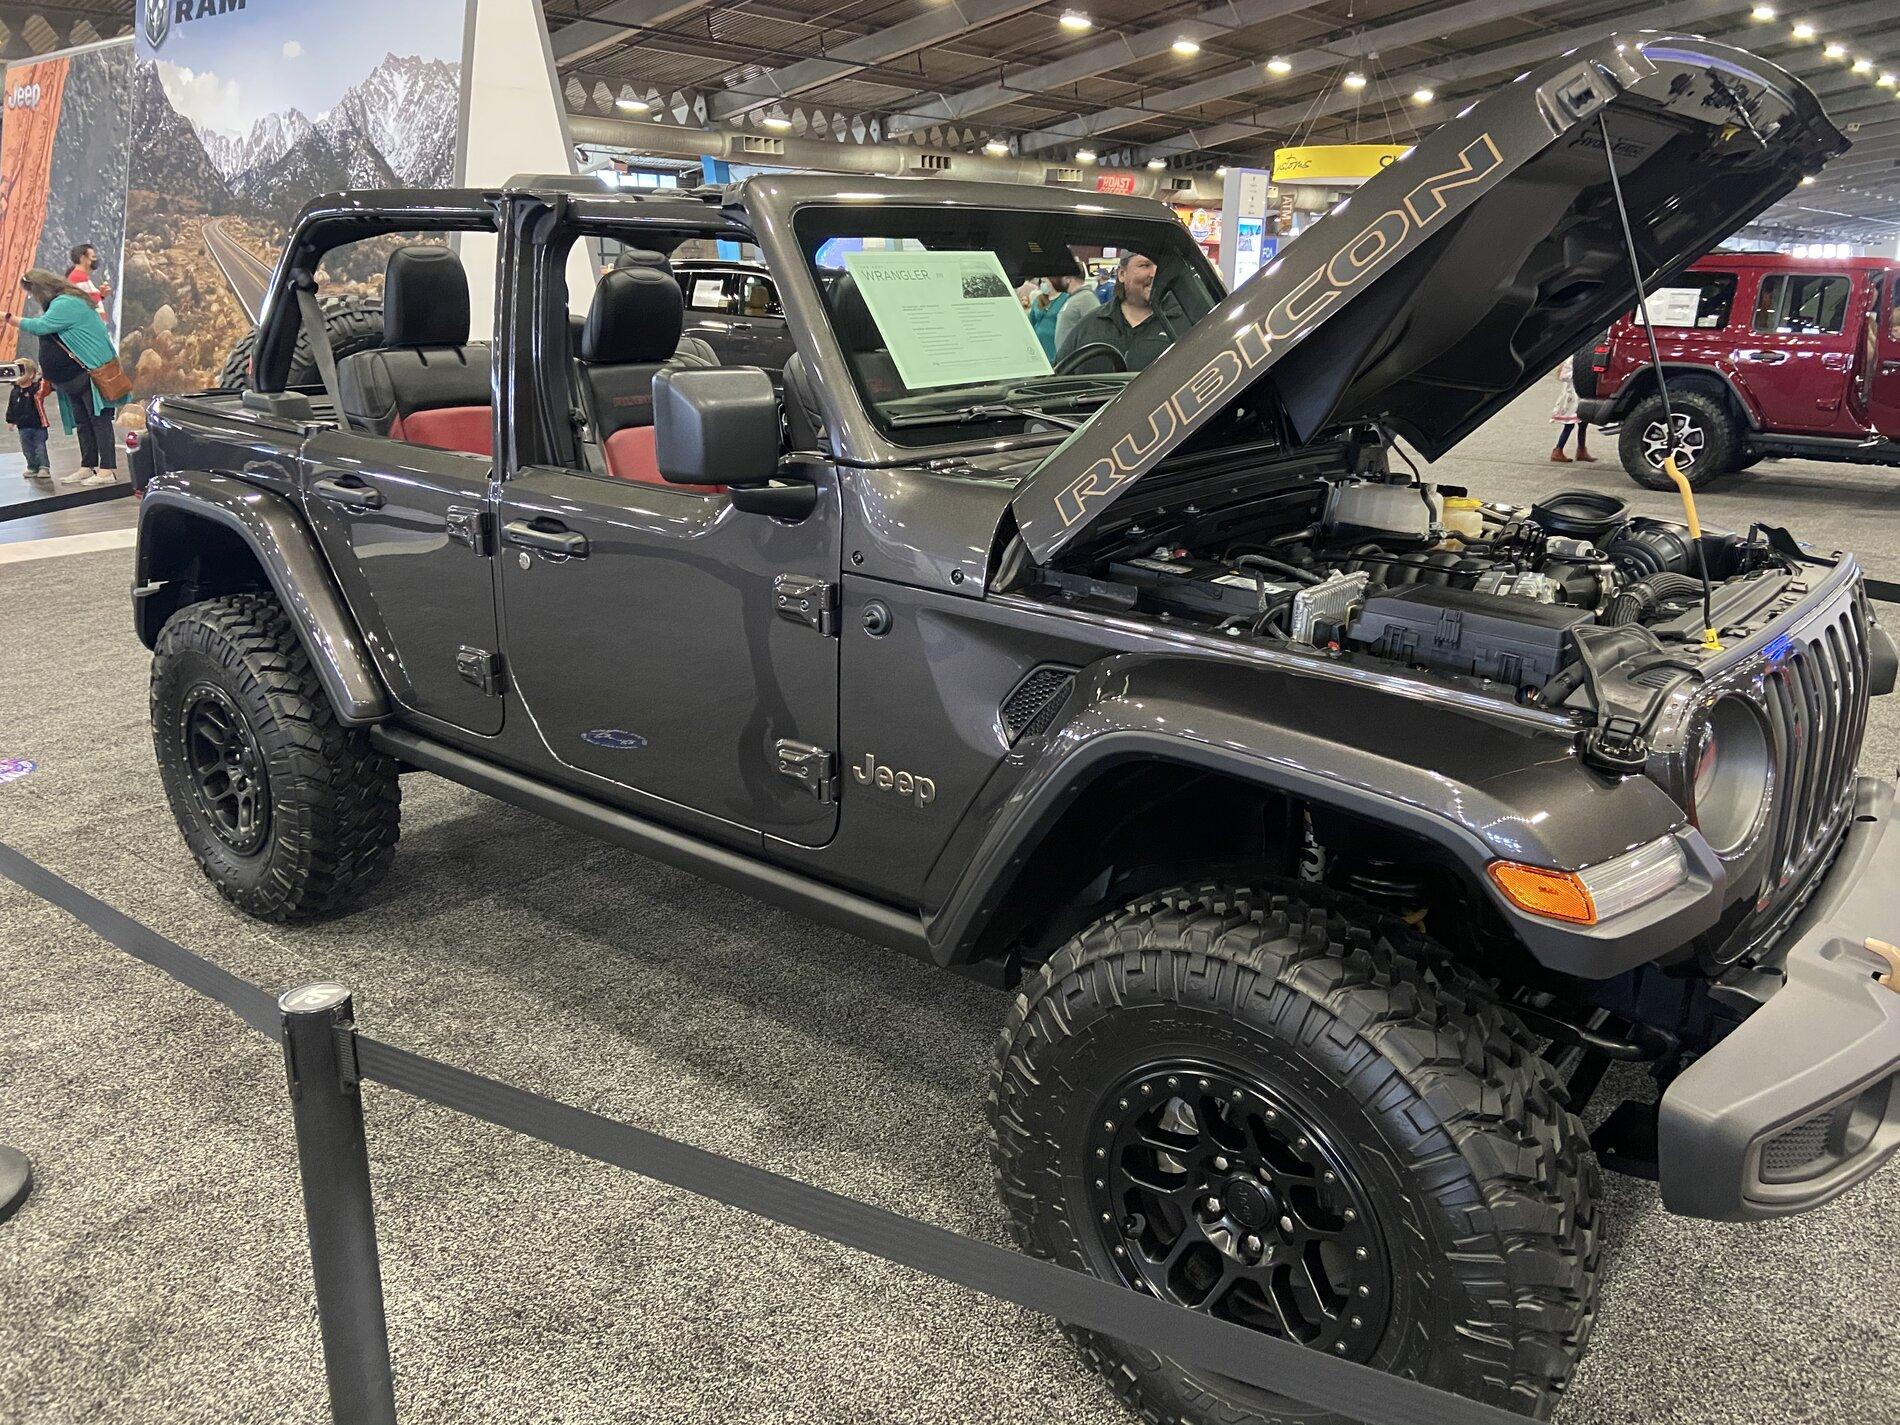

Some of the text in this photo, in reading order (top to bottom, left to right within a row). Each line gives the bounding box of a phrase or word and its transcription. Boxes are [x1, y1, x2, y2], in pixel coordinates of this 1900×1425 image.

[8, 80, 41, 110] Jeep
[1282, 196, 1293, 220] ATM
[861, 269, 930, 281] WRANGLER
[1053, 133, 1504, 527] RUBICON
[852, 753, 936, 809] Jeep
